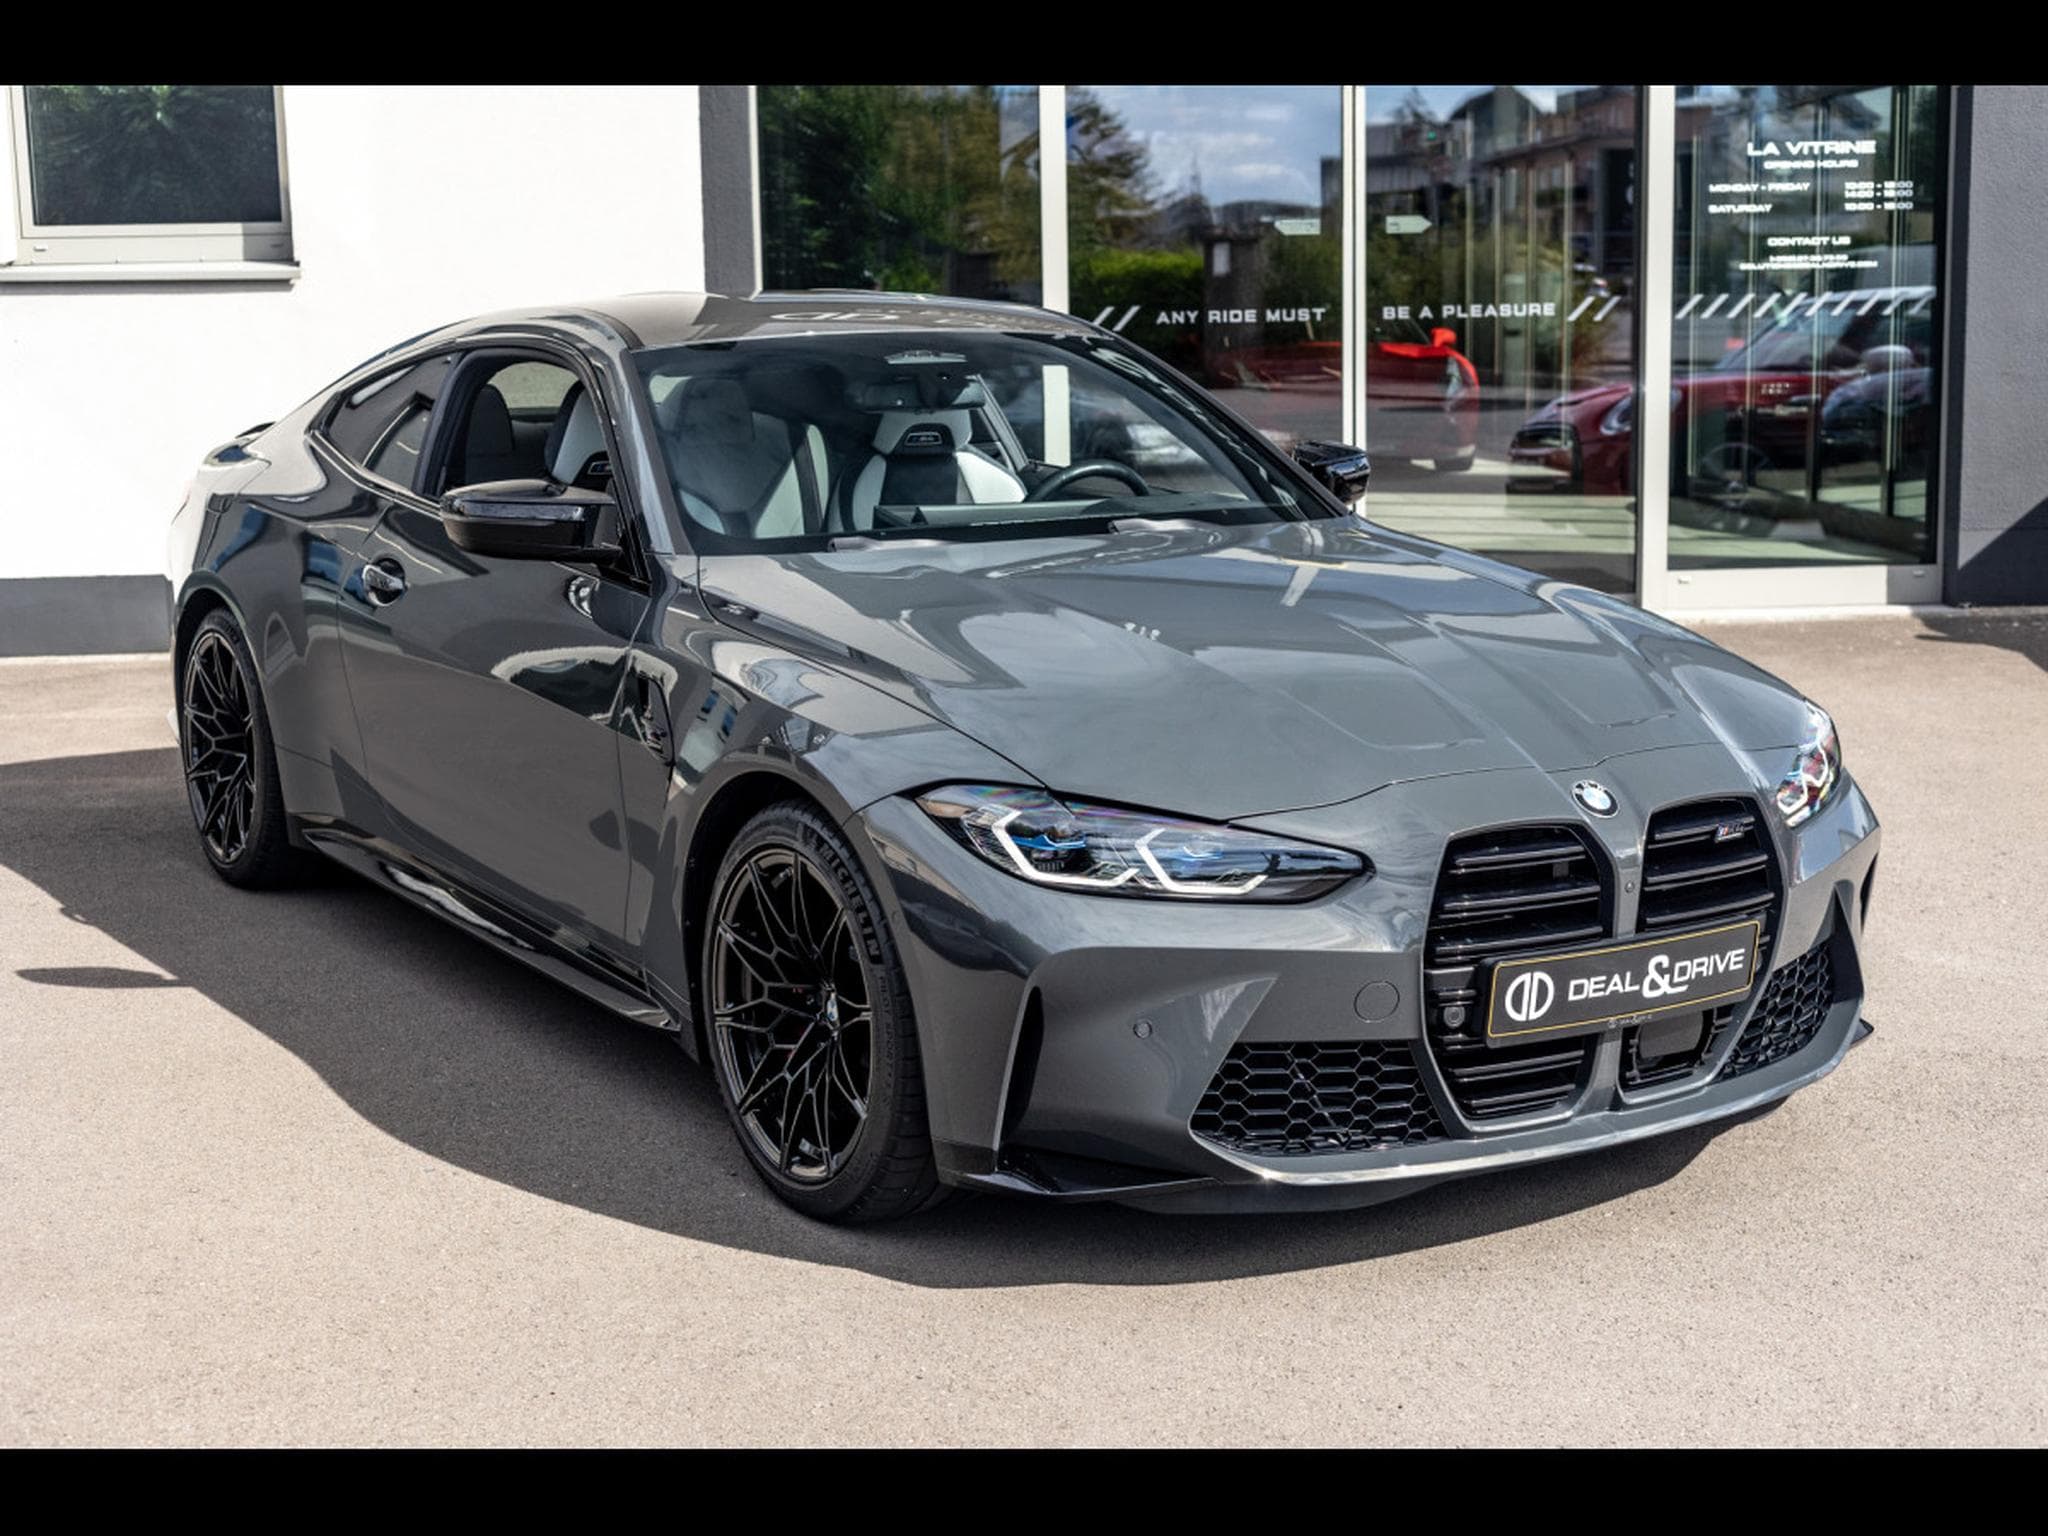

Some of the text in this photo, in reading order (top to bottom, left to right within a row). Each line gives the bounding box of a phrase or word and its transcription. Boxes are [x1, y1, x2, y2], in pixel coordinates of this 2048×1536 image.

[1746, 139, 1877, 156] LA VITRINE
[1708, 182, 1759, 193] MONDAY
[1767, 181, 1811, 192] FRIDAY
[1708, 203, 1773, 214] SATURDAY
[1767, 235, 1829, 247] CONTACT
[1156, 302, 1556, 324] ANY RIDE MUST BE A PLEASURE
[818, 841, 881, 956] MICHELIN
